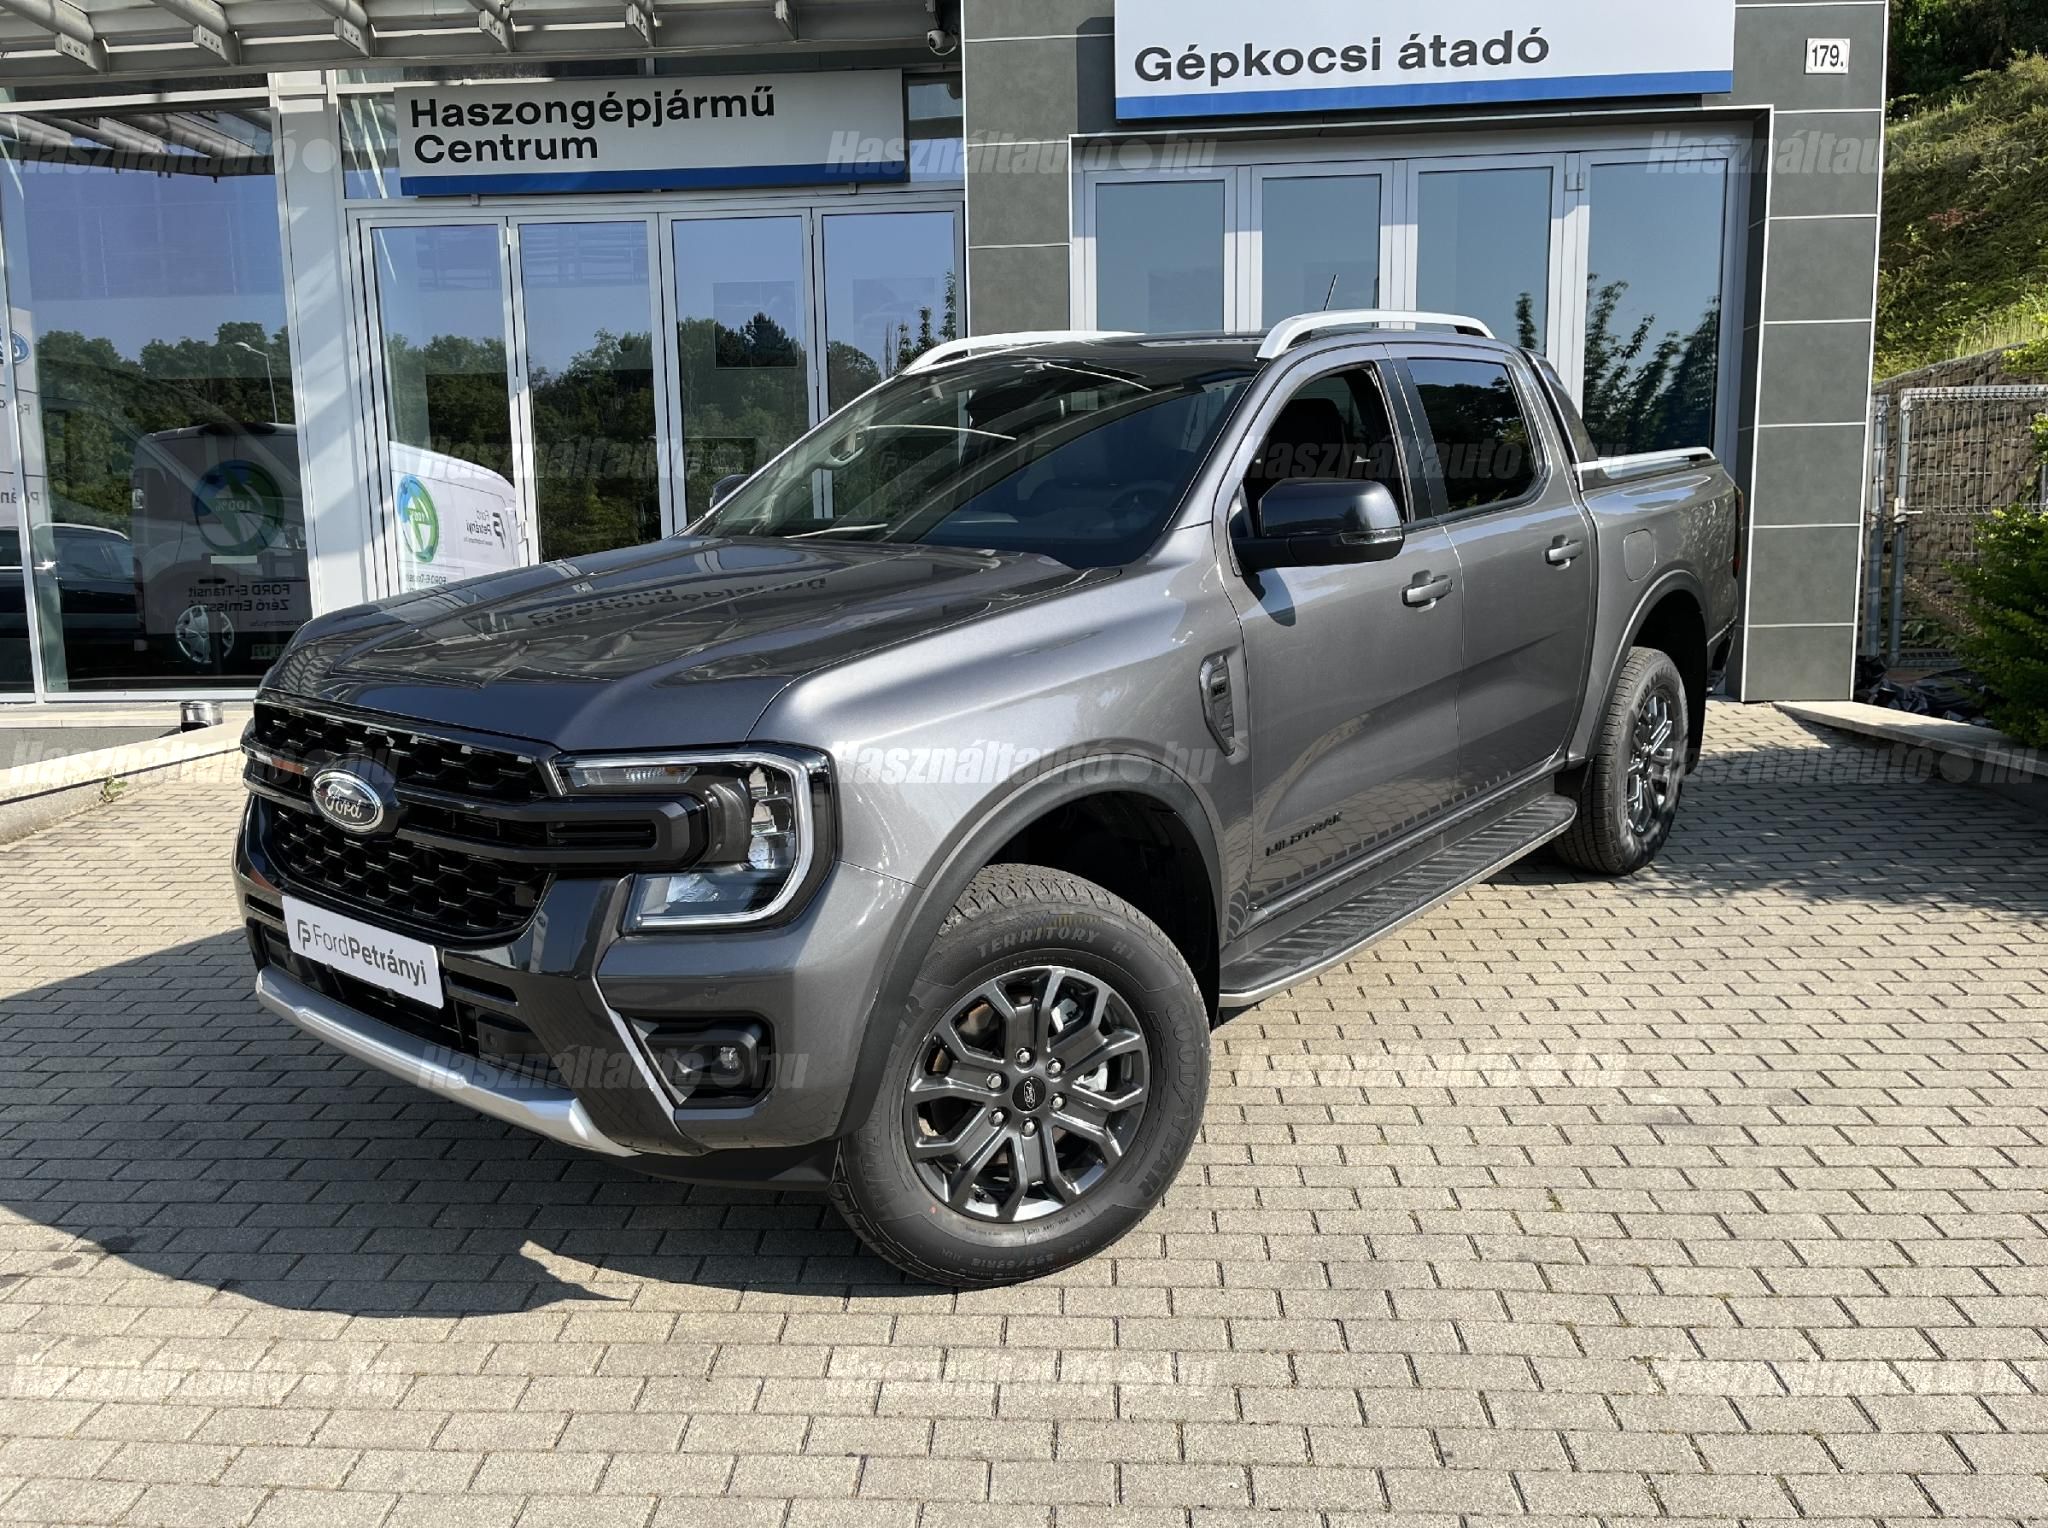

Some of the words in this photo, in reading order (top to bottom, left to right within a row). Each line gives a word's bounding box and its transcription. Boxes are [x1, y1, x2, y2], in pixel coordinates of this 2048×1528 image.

[1134, 37, 1381, 87] Gépkocsi
[1398, 26, 1550, 70] átadó
[1811, 44, 1844, 67] 179.
[410, 86, 775, 129] Haszongépjármű
[414, 133, 599, 164] Centrum
[324, 783, 363, 819] Ford
[312, 925, 427, 986] FordPetrányi
[976, 926, 1101, 958] TERRITORY
[1138, 1003, 1199, 1198] GOODYEAR
